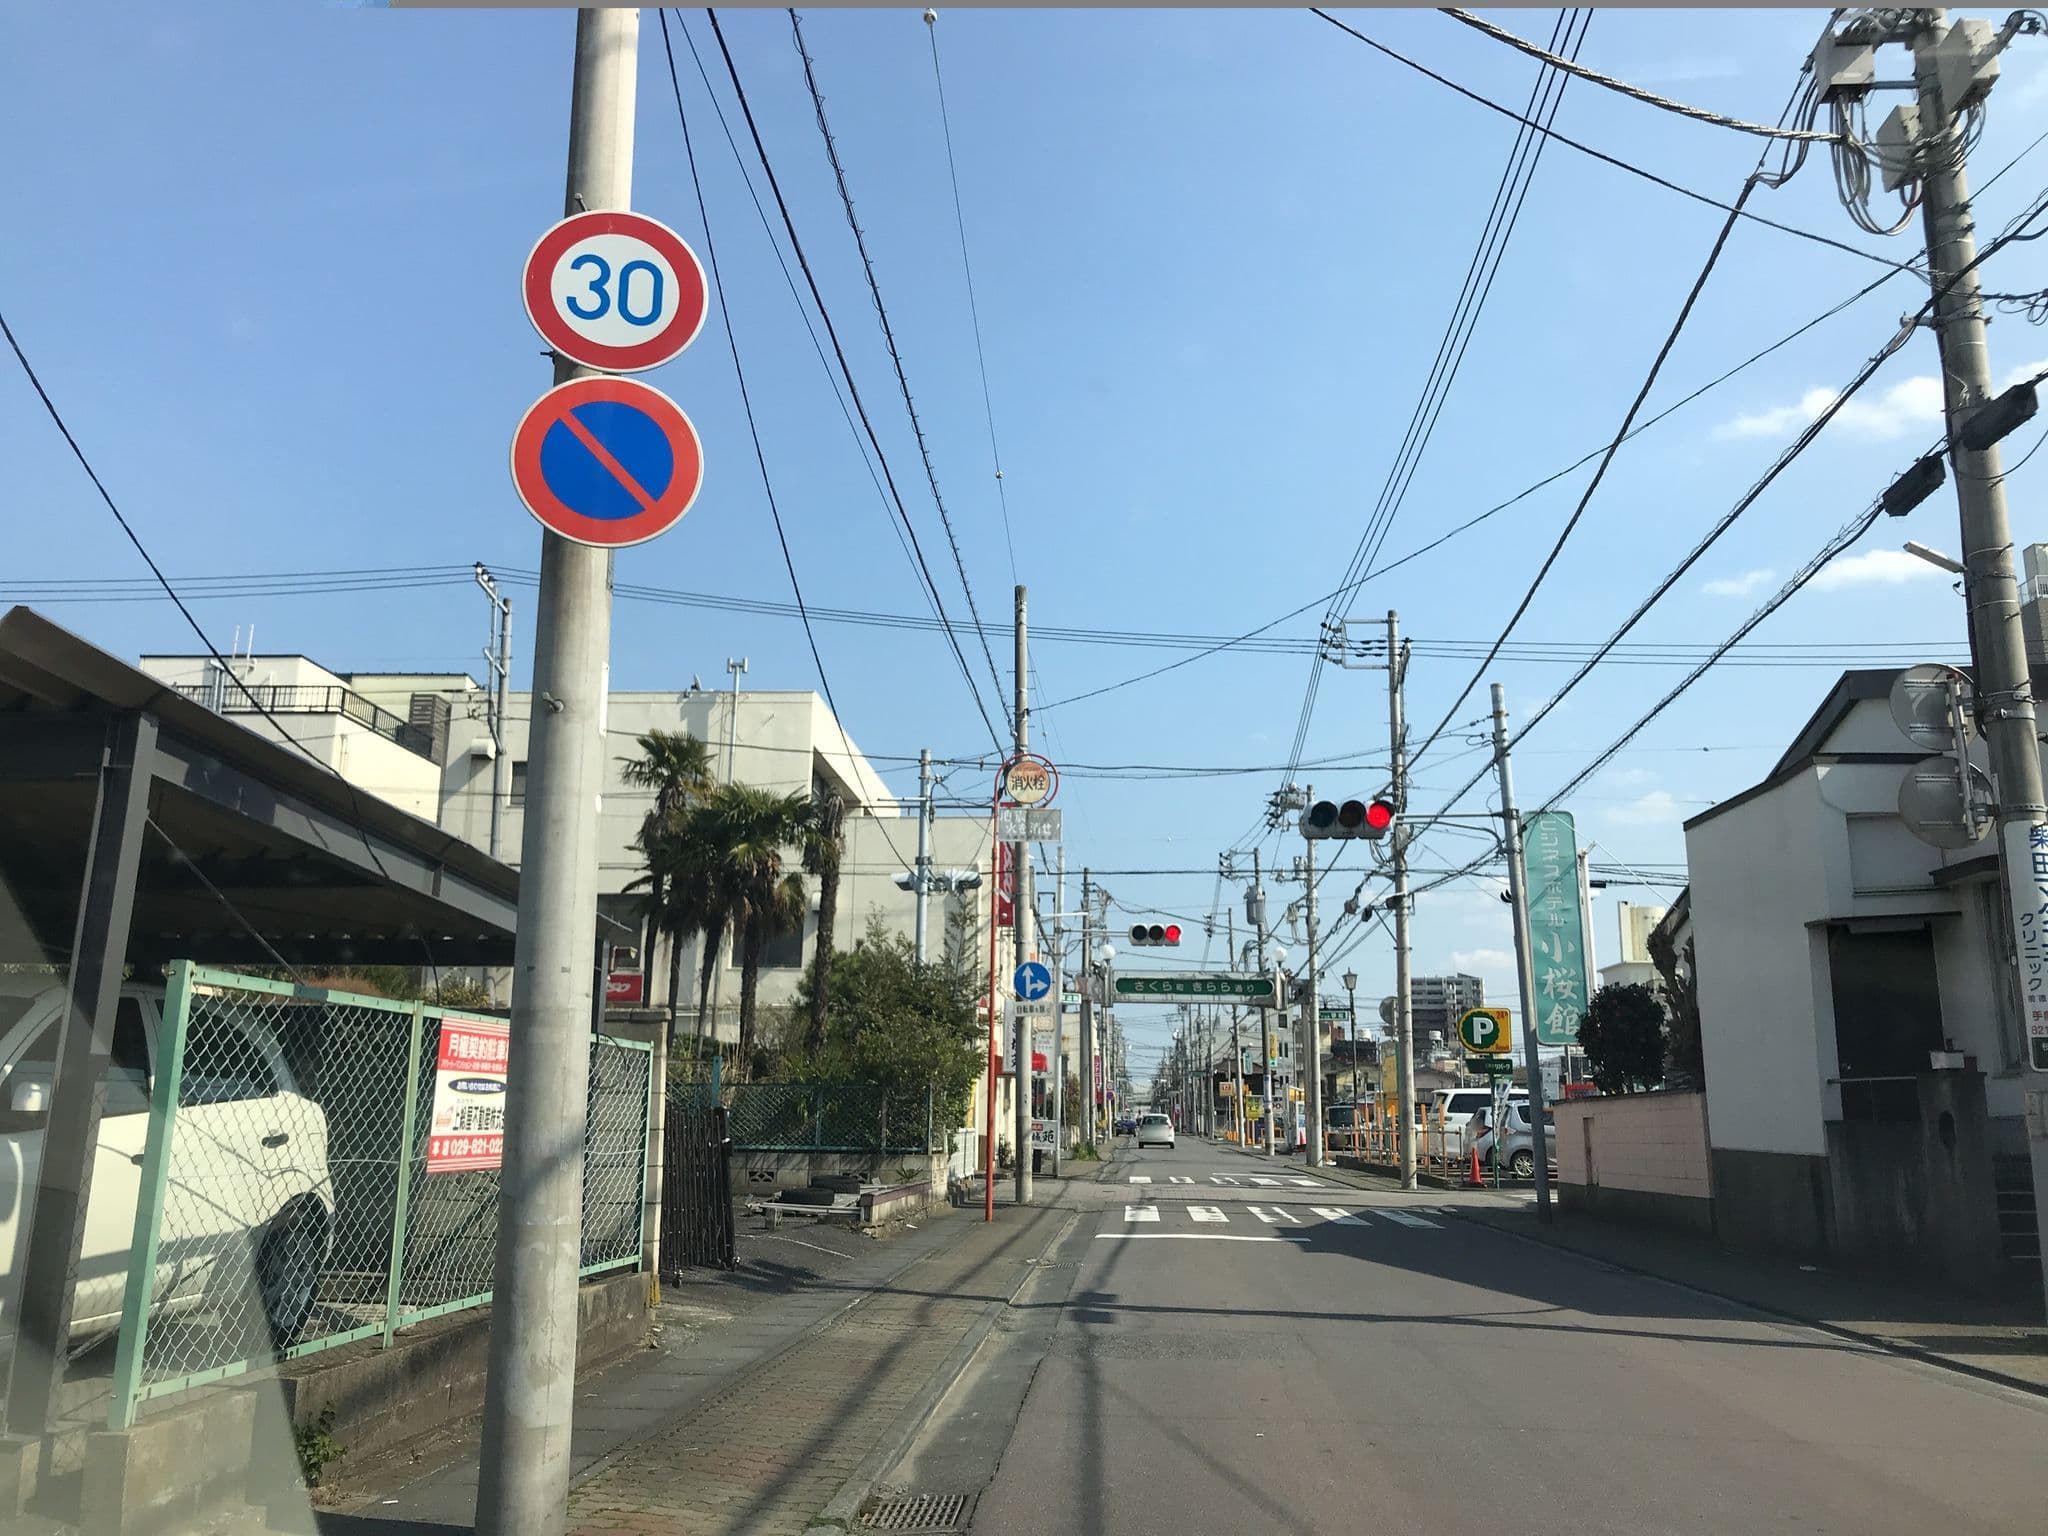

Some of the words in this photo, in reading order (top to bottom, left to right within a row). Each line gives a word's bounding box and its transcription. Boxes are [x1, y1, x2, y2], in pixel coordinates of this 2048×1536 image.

[566, 254, 663, 326] 30
[1011, 775, 1046, 791] 消火栓
[1541, 931, 1581, 1036] 小桜館
[2020, 913, 2043, 992] クリニック
[1472, 1017, 1494, 1045] P
